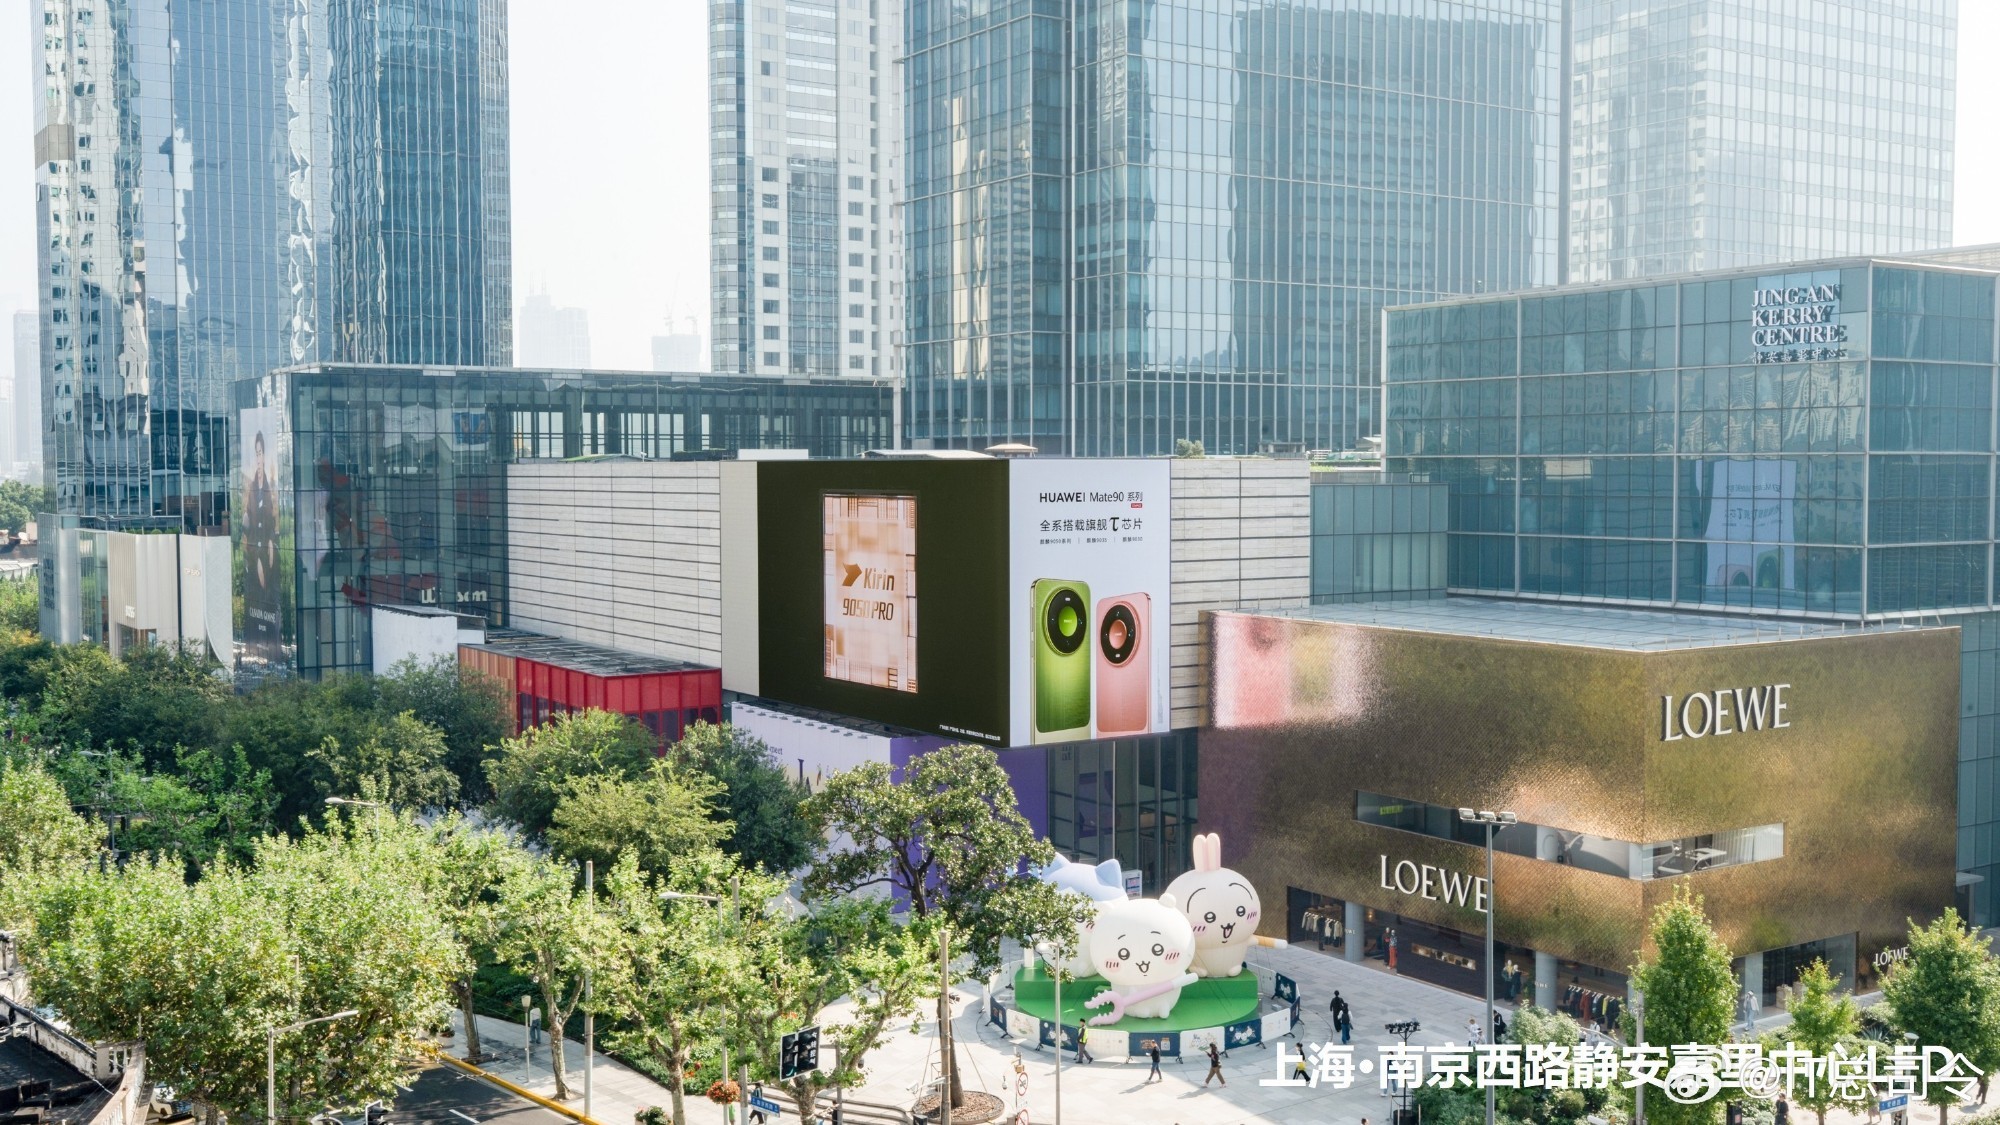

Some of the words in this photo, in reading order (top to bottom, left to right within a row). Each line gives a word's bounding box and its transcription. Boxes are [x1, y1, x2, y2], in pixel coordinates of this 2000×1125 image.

[1752, 304, 1829, 326] KERRY
[1752, 325, 1839, 347] CENTRE
[1039, 492, 1086, 503] HUAWEI
[1090, 491, 1124, 502] Mate90
[1127, 491, 1143, 502] 系列
[864, 567, 895, 591] Kirin
[1663, 683, 1792, 742] LOEWE
[1380, 854, 1492, 913] LOEWE
